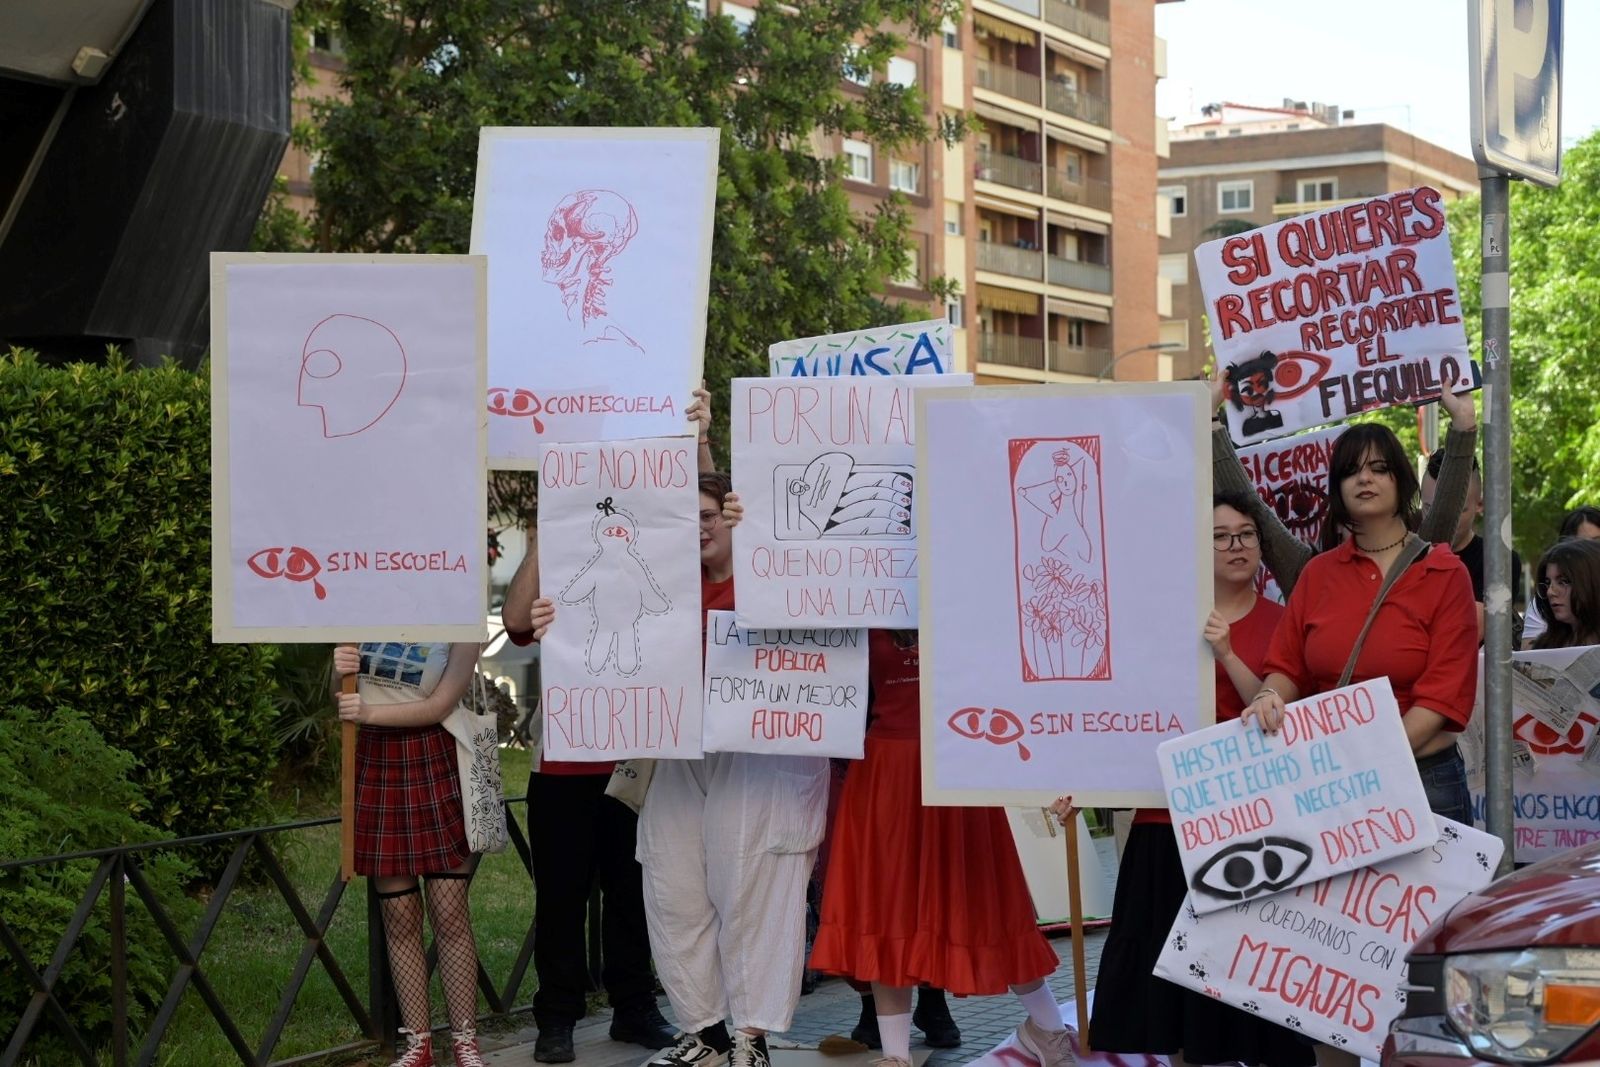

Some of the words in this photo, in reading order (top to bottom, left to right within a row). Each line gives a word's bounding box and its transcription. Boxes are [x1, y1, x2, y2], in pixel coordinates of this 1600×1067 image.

[1221, 232, 1272, 286] SI
[1277, 185, 1446, 268] QUIERES
[1216, 248, 1423, 340] RECORTAR
[1300, 288, 1461, 352] RECORTATE
[1357, 334, 1402, 367] EL
[544, 395, 584, 415] CON
[588, 395, 675, 416] ESCUELA
[749, 386, 822, 445] POR
[830, 386, 872, 445] UN
[542, 449, 593, 489] QUE
[598, 447, 637, 490] NO
[643, 447, 689, 489] NOS
[327, 551, 368, 573] SIN
[375, 551, 467, 573] ESCUELA
[751, 547, 802, 580] QUE
[806, 548, 842, 576] NO
[786, 588, 837, 617] UNA
[848, 588, 909, 616] LATA
[714, 616, 741, 646] LA
[755, 646, 827, 673] PÚBLICA
[547, 686, 684, 750] RECORTEN
[708, 677, 765, 704] FORMA
[769, 683, 790, 704] UN
[797, 684, 857, 709] MEJOR
[752, 709, 822, 742] FUTURO
[1030, 712, 1074, 735] SIN
[1082, 710, 1184, 734] ESCUELA
[1171, 735, 1242, 780] HASTA
[1245, 727, 1273, 758] EL
[1281, 686, 1376, 747] DINERO
[1170, 779, 1217, 815] QUE
[1214, 770, 1243, 803] TE
[1243, 751, 1301, 795] ECHAS
[1309, 741, 1342, 776] AL
[1180, 797, 1274, 851] BOLSILLO
[1293, 768, 1382, 817] NECESITA
[1320, 807, 1417, 865] DISEÑO
[1258, 899, 1359, 955] QUEDARNOS
[1359, 941, 1397, 971] CON
[1228, 933, 1381, 1033] MIGAJAS
